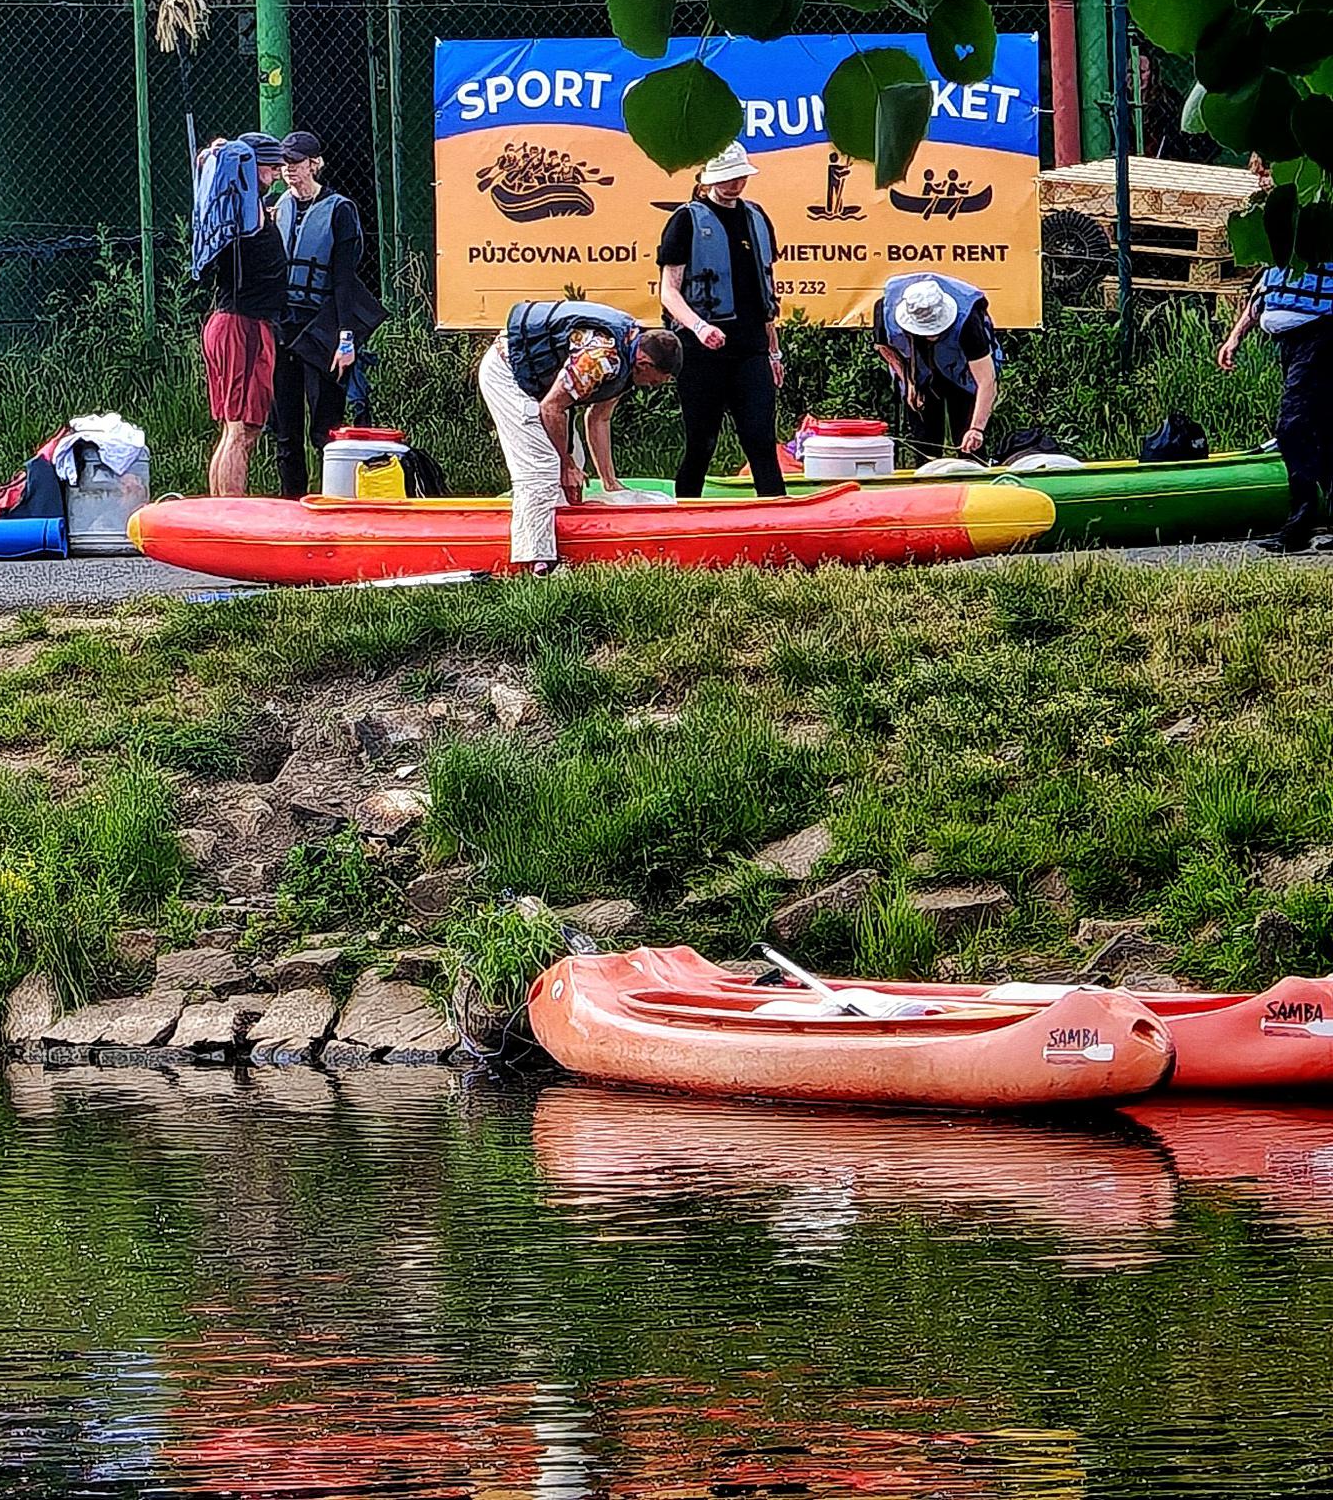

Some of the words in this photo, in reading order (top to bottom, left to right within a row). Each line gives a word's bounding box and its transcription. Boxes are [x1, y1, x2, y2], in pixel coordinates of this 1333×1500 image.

[456, 69, 613, 120] SPORT
[931, 83, 1021, 124] KET
[468, 240, 582, 263] PŮJČOVNA
[587, 240, 638, 263] LODÍ
[887, 245, 947, 262] BOAT
[952, 245, 1009, 262] RENT
[799, 281, 827, 295] 232
[1266, 1001, 1325, 1023] SAMBA
[1047, 1028, 1100, 1049] SAMBA
